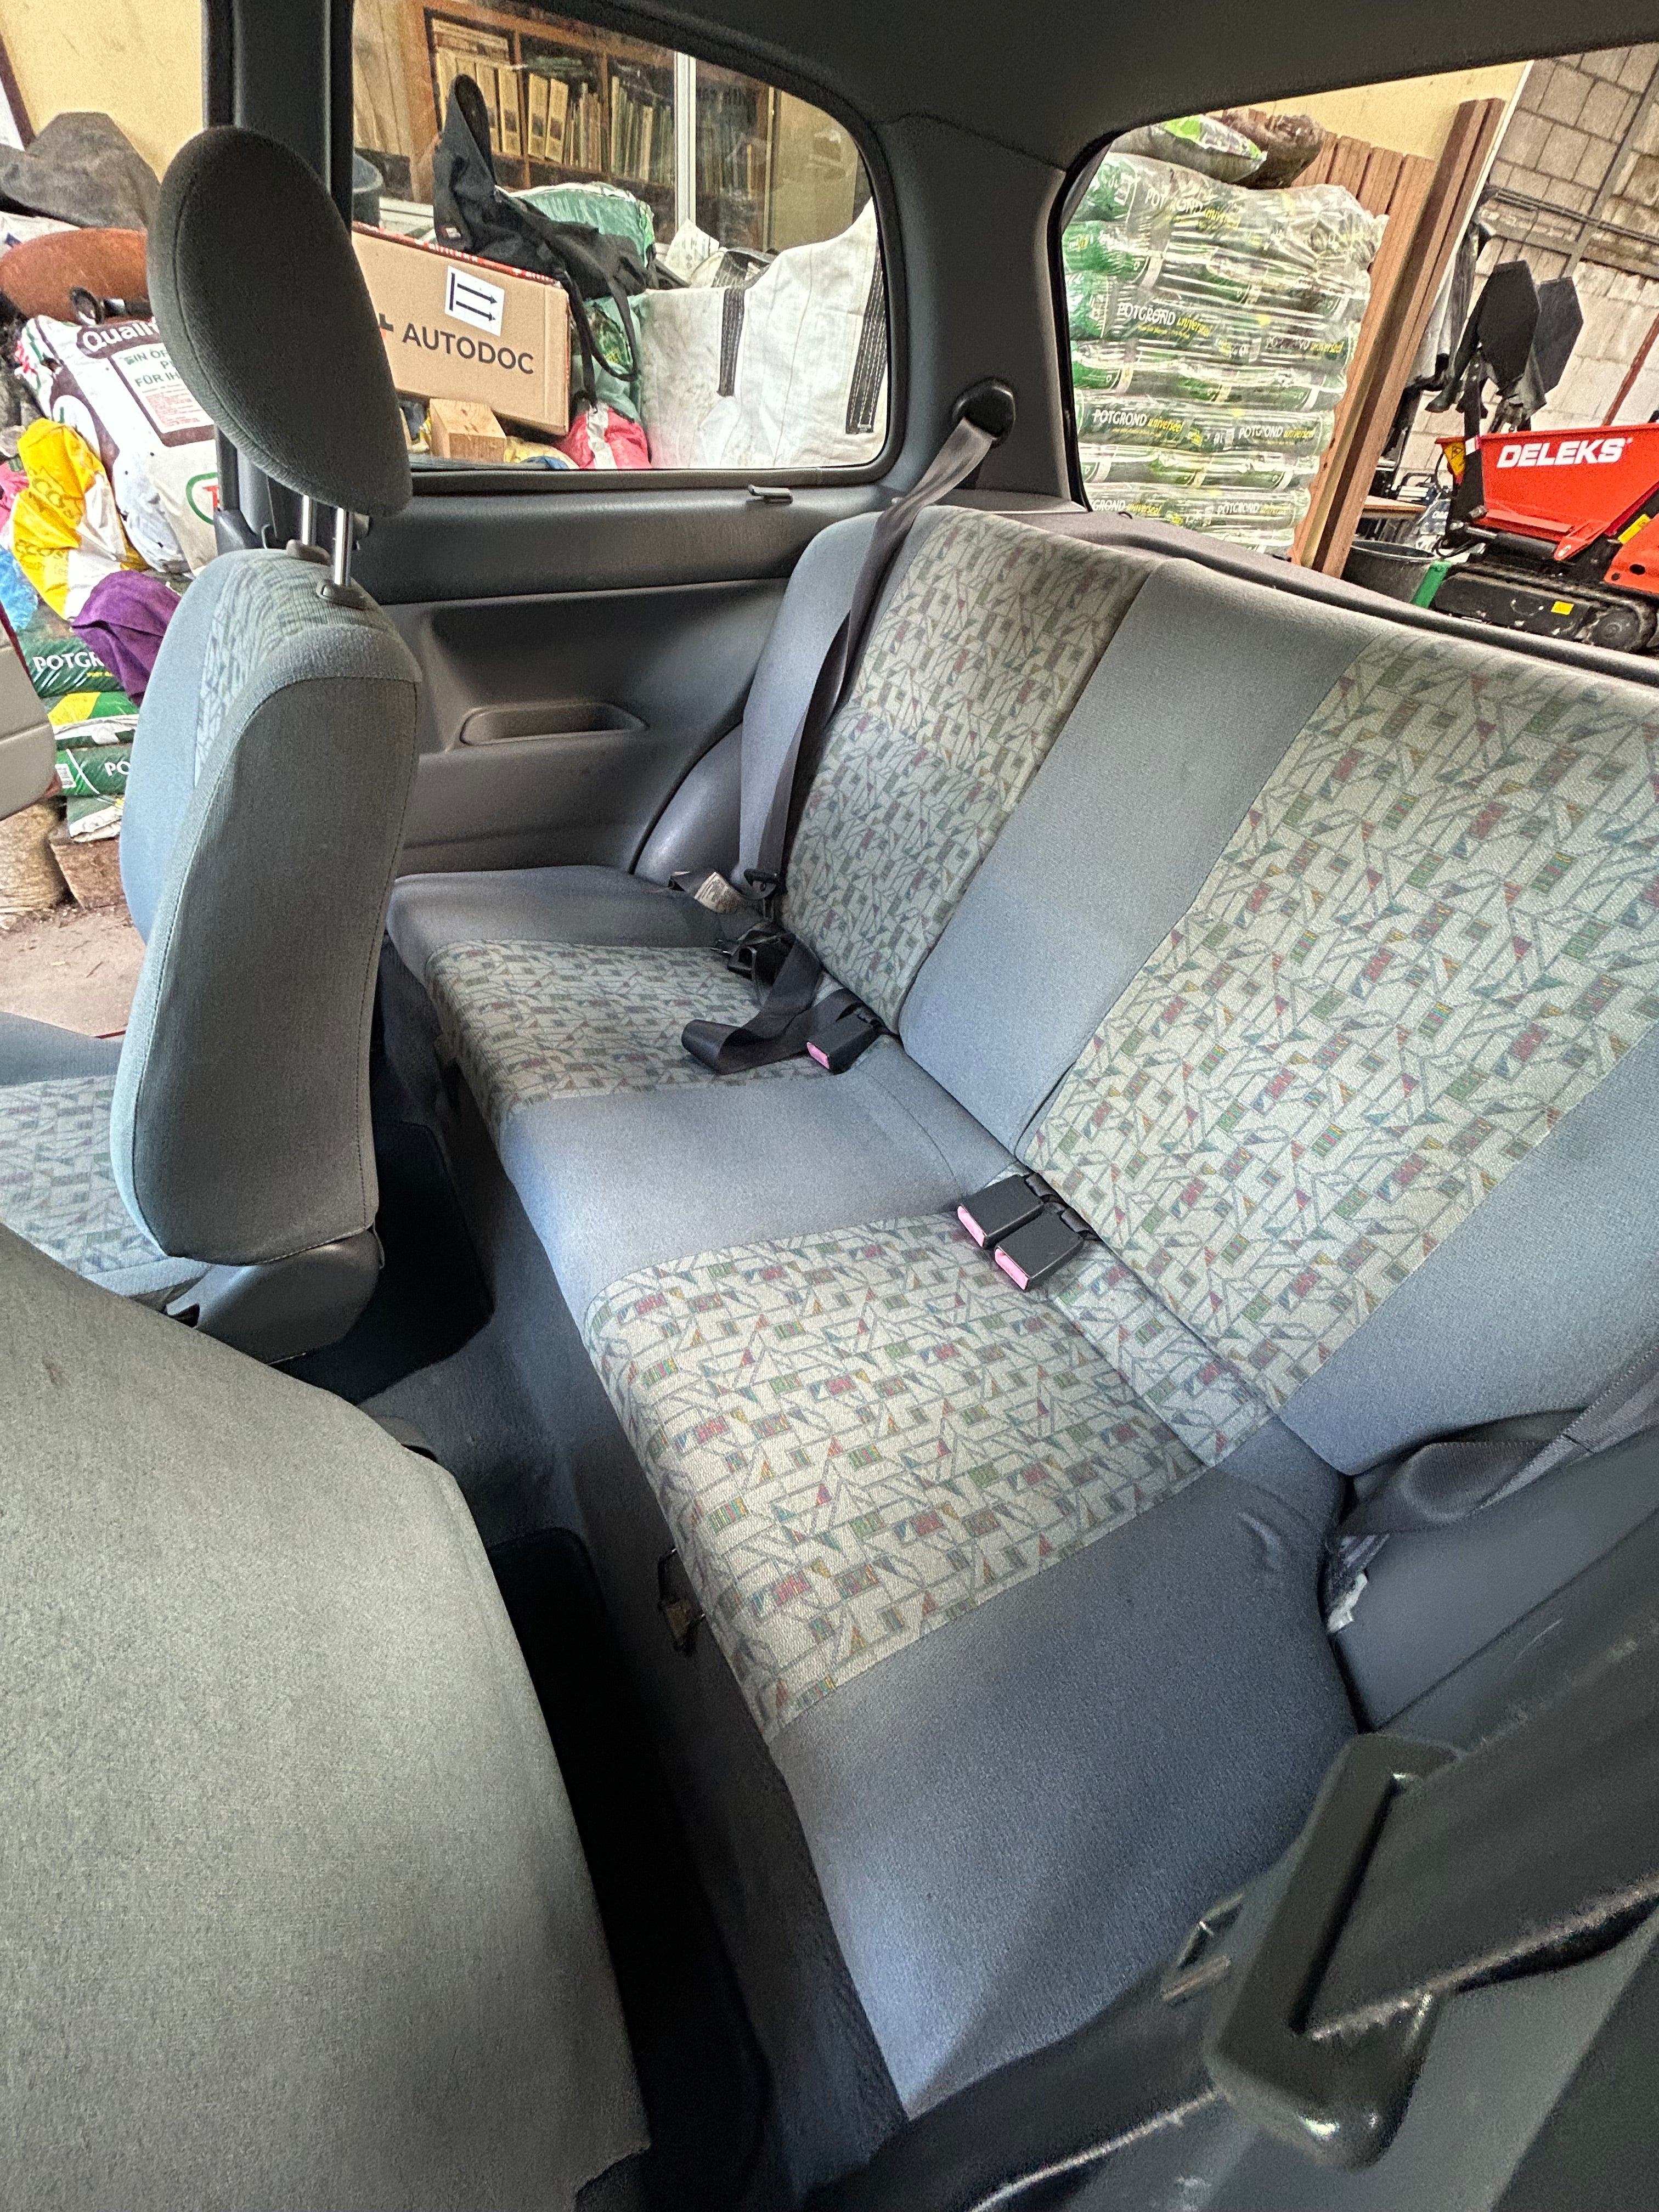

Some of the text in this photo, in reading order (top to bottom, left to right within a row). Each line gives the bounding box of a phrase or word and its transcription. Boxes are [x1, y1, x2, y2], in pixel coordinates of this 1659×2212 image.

[402, 323, 534, 375] AUTODOC
[135, 374, 164, 387] FÜR
[1092, 409, 1148, 427] POTGROND
[1147, 415, 1184, 433] universeel
[1496, 438, 1626, 468] DELEKS
